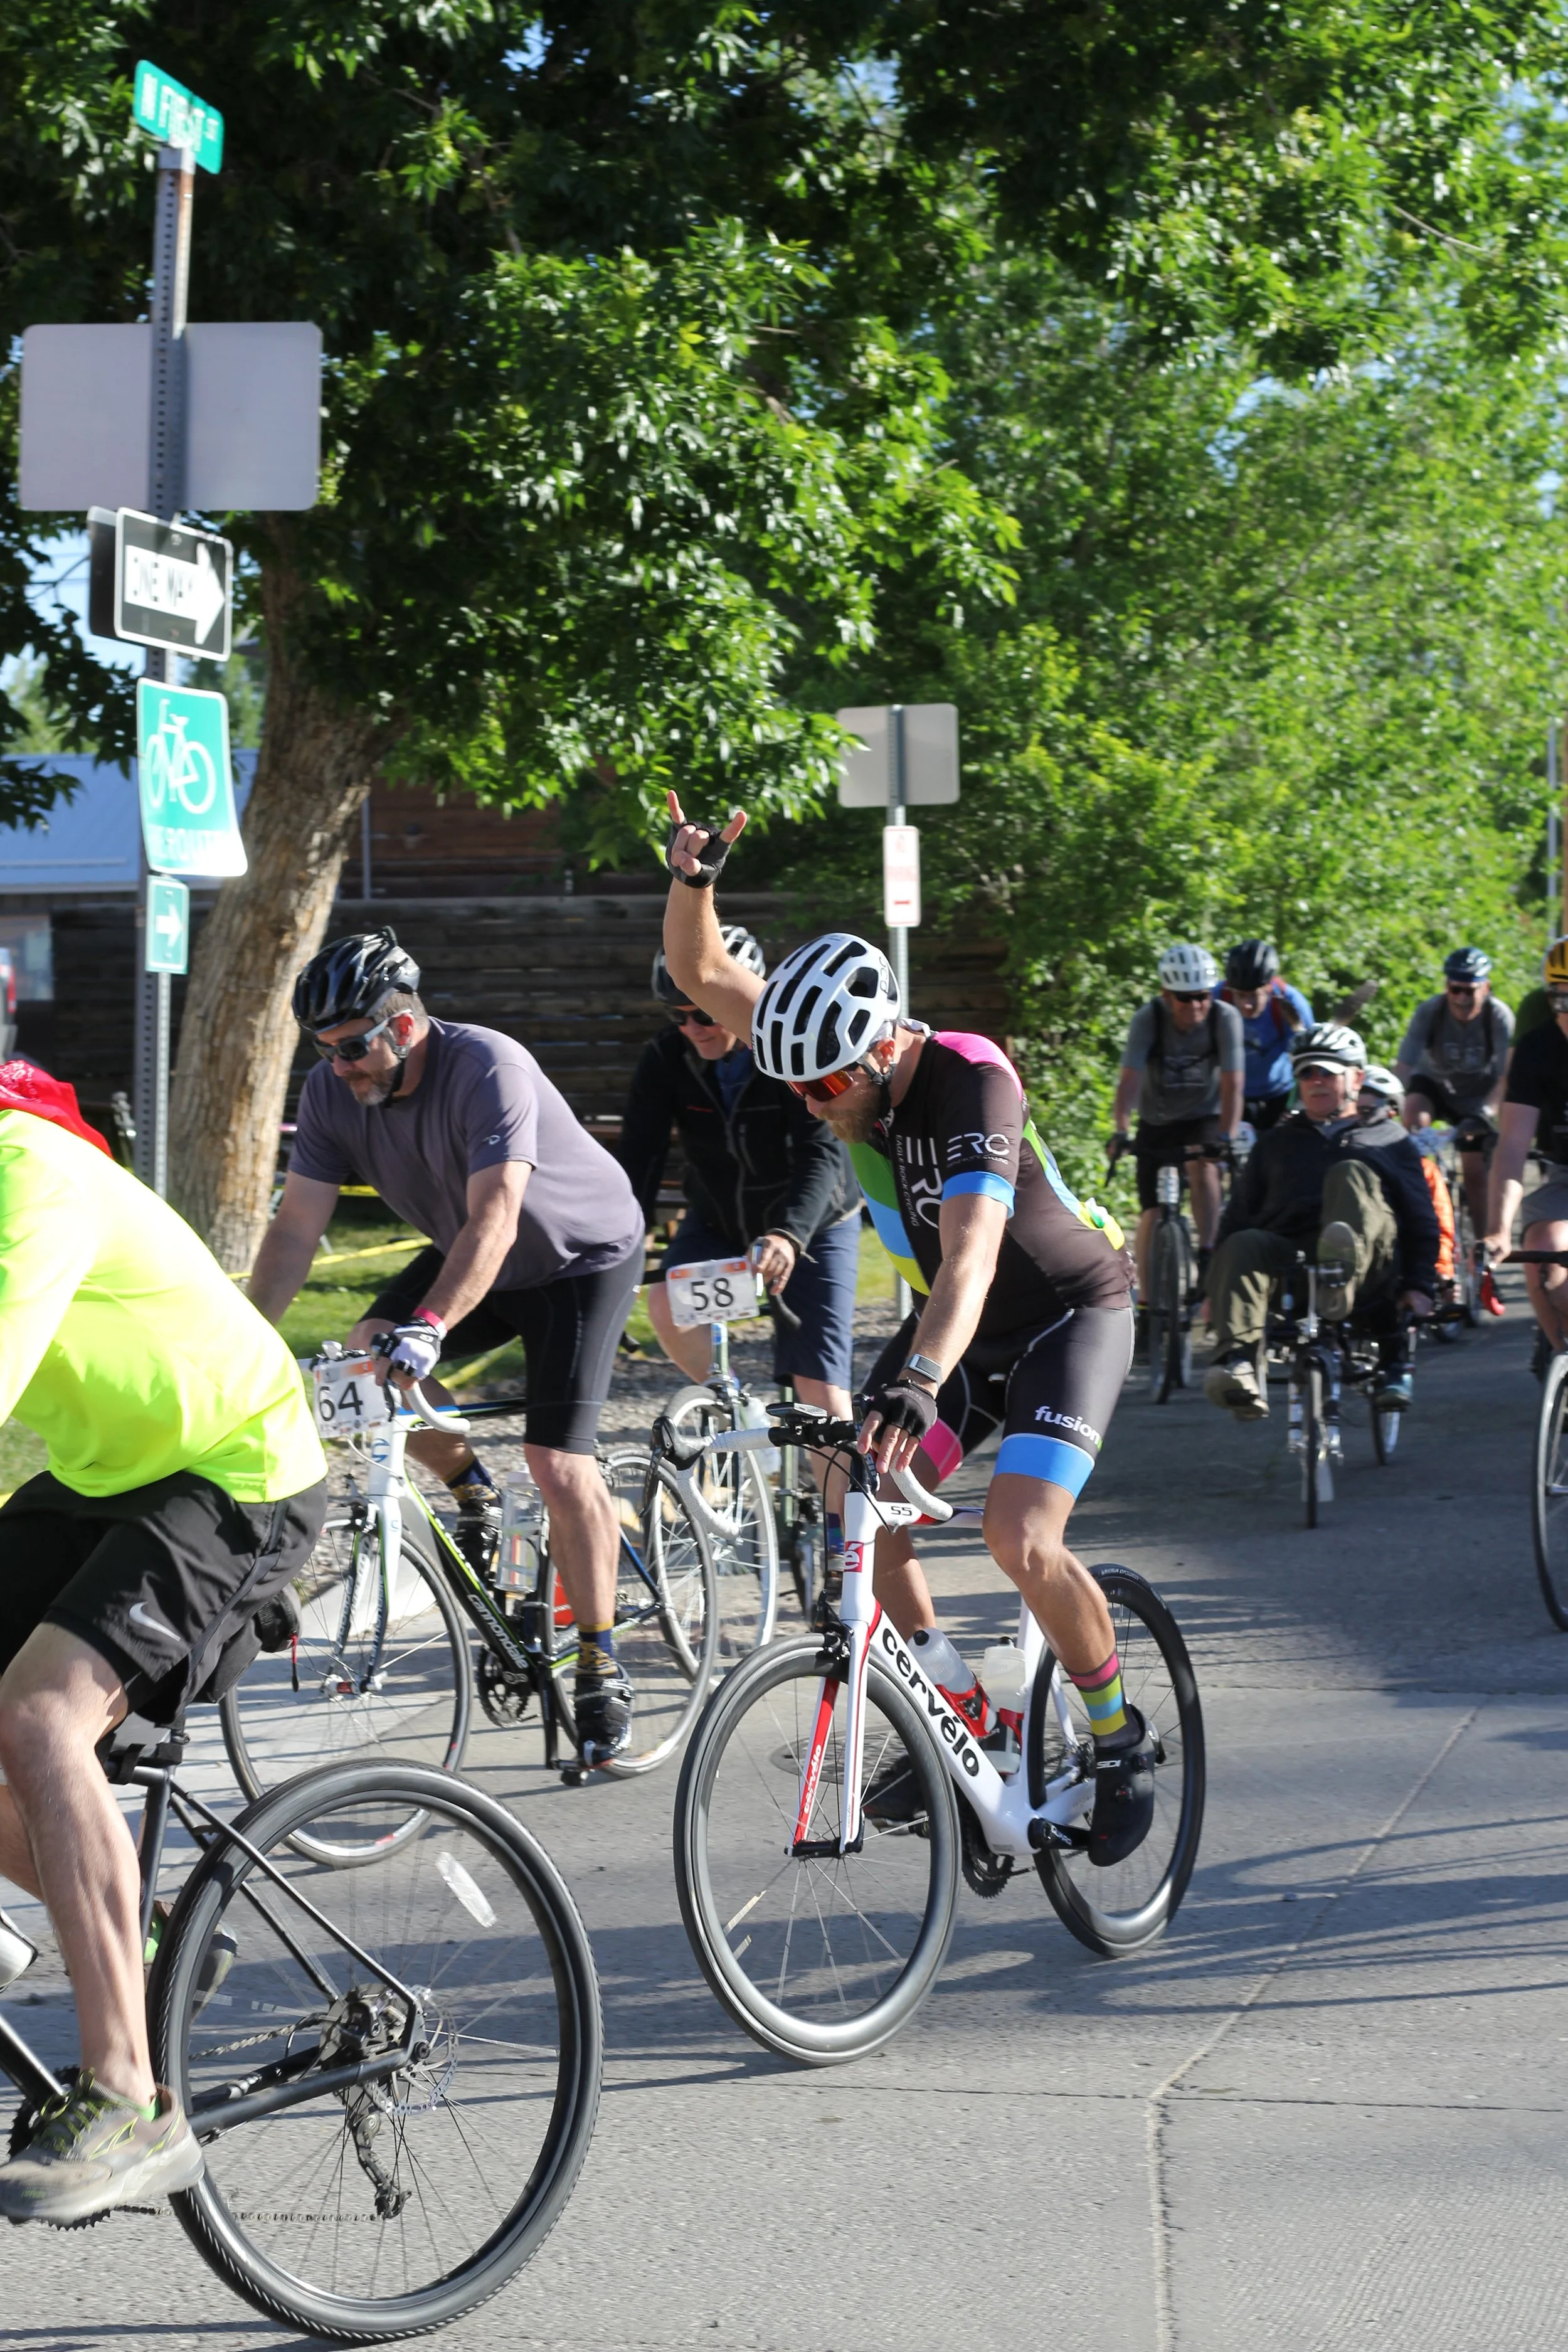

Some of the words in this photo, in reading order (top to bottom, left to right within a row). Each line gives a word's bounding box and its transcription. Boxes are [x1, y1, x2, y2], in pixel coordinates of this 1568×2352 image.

[895, 1134, 904, 1163] EAGLE
[946, 1132, 1010, 1162] ERC
[898, 1165, 909, 1190] ROCK
[904, 1191, 920, 1227] CYCLING
[691, 1278, 734, 1311] 58
[319, 1381, 364, 1422] 64
[1034, 1406, 1101, 1446] fusion
[467, 1594, 529, 1670] cannondale
[882, 1628, 980, 1777] cervélo
[1096, 1759, 1121, 1769] SIDI
